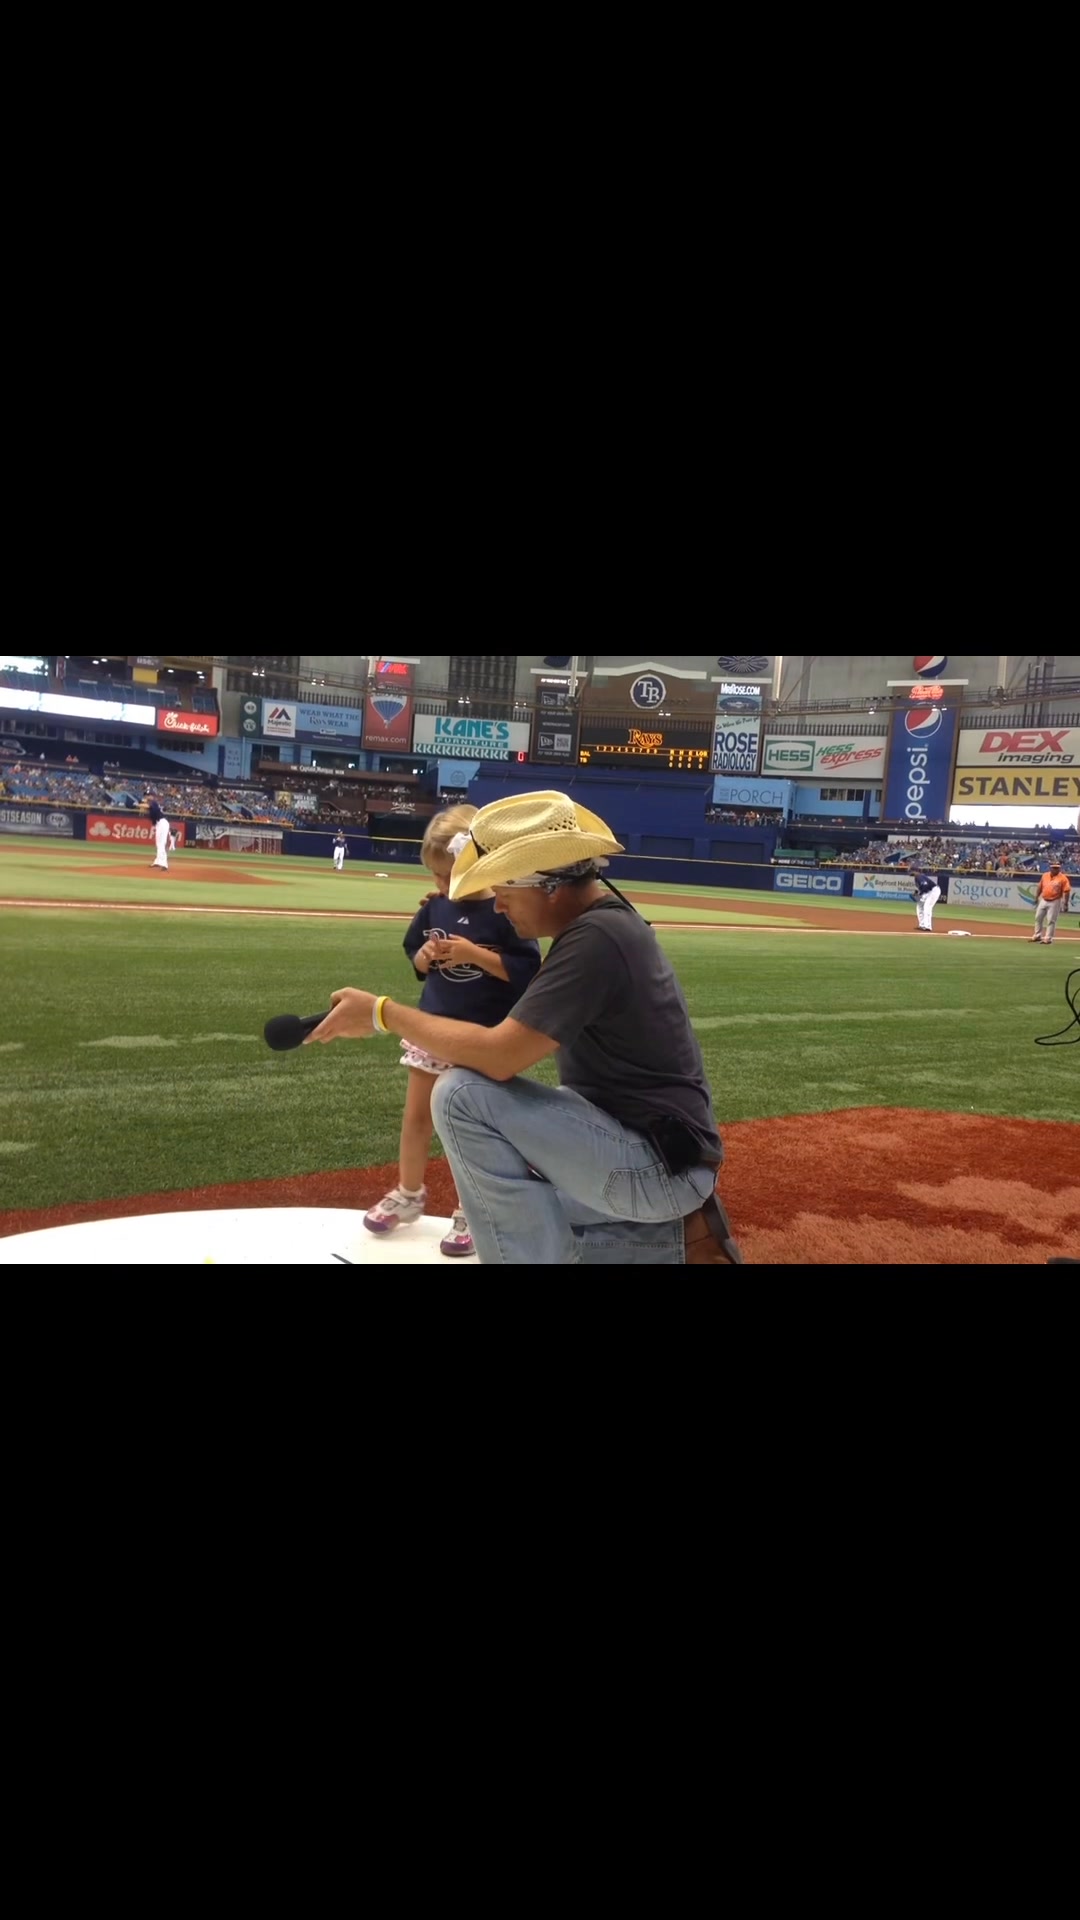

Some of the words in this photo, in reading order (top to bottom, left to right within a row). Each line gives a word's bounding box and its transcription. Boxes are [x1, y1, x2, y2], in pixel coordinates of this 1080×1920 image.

[637, 680, 661, 704] TB
[299, 709, 321, 717] WEAR
[322, 711, 344, 719] WHAT
[345, 713, 360, 721] THE
[327, 719, 350, 728] WEAR
[435, 717, 510, 740] KANE'S
[365, 735, 407, 744] remax.com
[436, 738, 504, 749] FURNITURE
[714, 732, 758, 753] ROSE
[979, 730, 1071, 753] DEX
[768, 750, 811, 762] HESS
[816, 743, 855, 757] HESS
[820, 748, 884, 765] express
[997, 752, 1074, 764] imaging
[712, 752, 757, 771] RADIOLOGY
[905, 747, 931, 820] pepsi
[730, 788, 783, 805] PORCH
[776, 872, 842, 891] GEICO
[953, 880, 1012, 901] Sagicor
